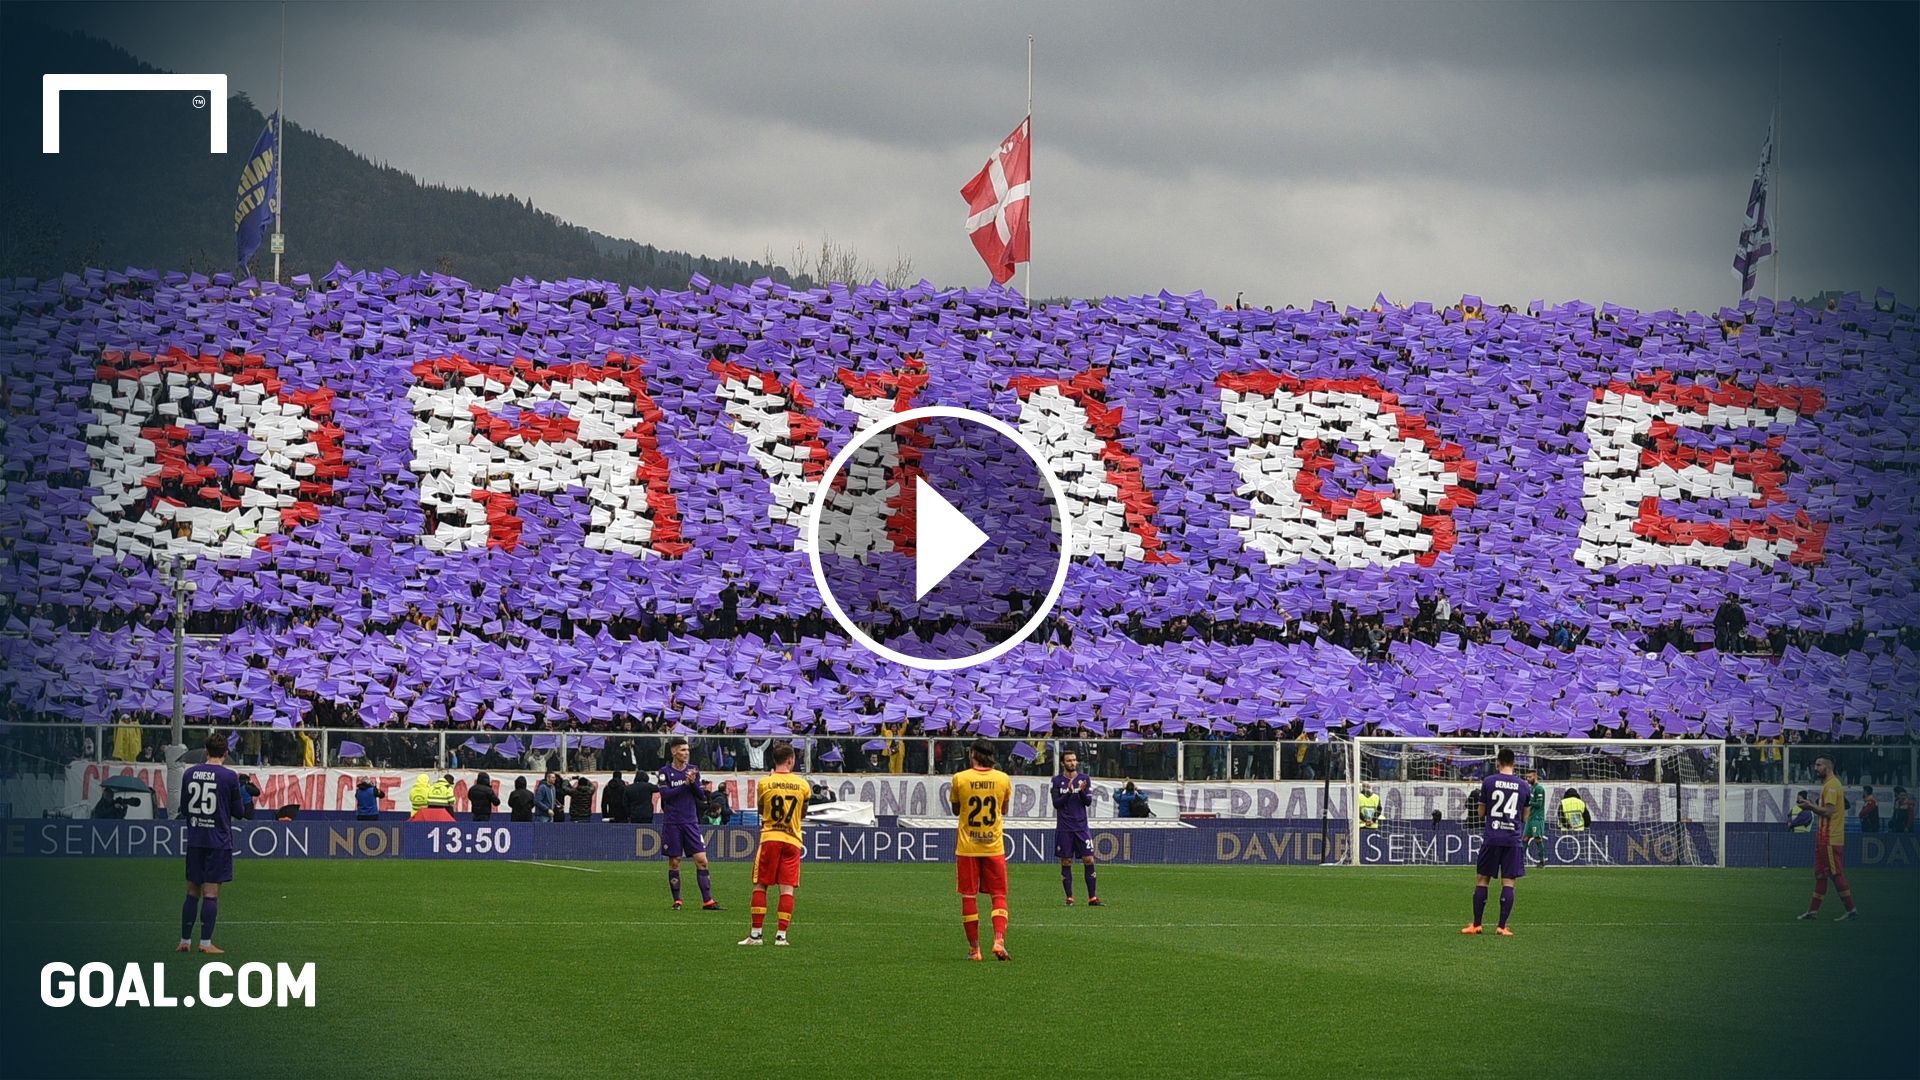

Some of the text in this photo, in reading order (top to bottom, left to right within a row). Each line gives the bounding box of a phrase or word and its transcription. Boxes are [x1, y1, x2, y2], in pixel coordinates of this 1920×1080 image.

[193, 771, 215, 781] CHIESA
[768, 782, 800, 790] LOMBARDI
[970, 781, 995, 790] VENUTI
[1495, 780, 1519, 790] BENASSI
[188, 782, 217, 815] 25
[771, 795, 798, 824] 87
[968, 796, 997, 828] 23
[1491, 790, 1519, 819] 24
[1744, 788, 1792, 822] IN
[329, 827, 399, 857] NOI
[427, 827, 511, 853] 13:50
[1093, 832, 1131, 862] OI
[1366, 833, 1485, 863] SEMPR
[1526, 834, 1609, 863] CON
